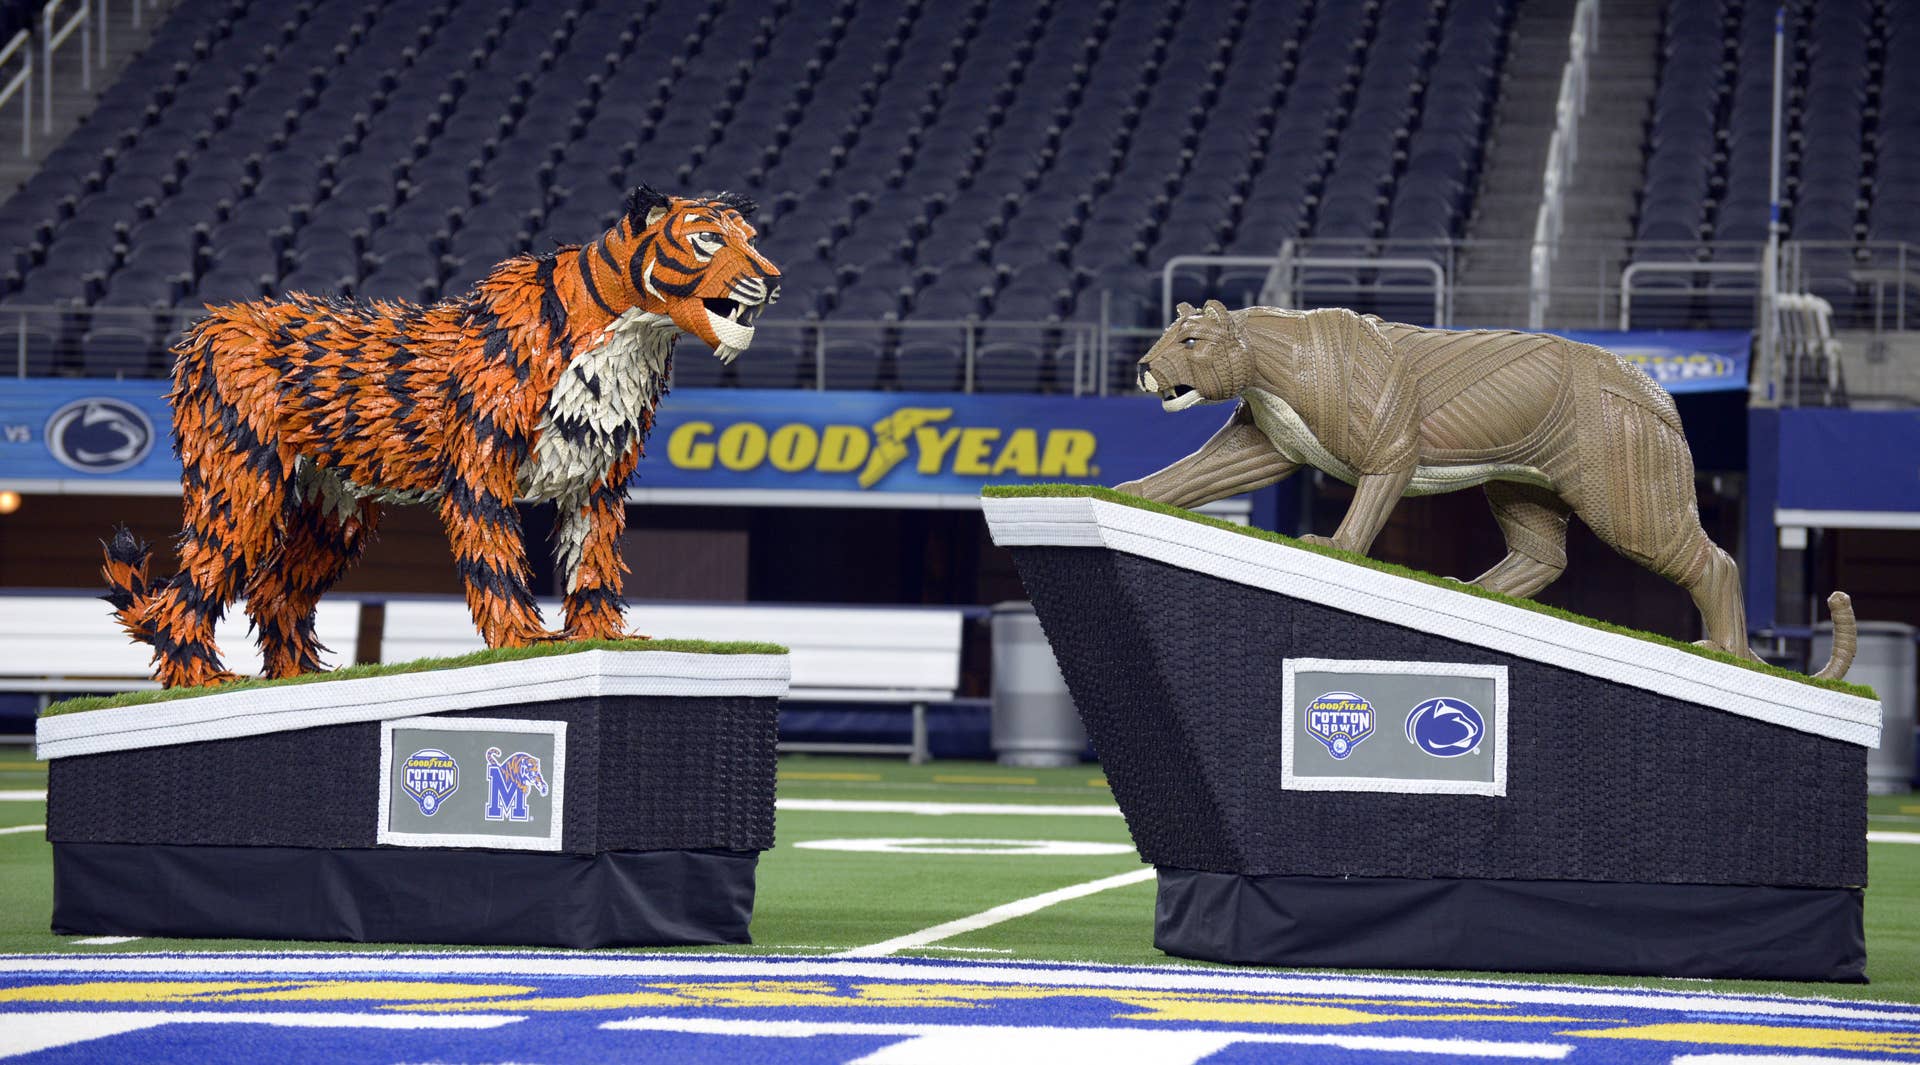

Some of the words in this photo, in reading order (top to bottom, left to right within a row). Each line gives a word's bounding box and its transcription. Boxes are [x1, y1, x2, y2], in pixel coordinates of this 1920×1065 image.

[667, 419, 1098, 479] GOODYEAR
[1313, 702, 1368, 711] GOODYEAR
[1311, 711, 1370, 733] COTTON
[1322, 724, 1359, 737] BOWL
[408, 759, 453, 768] GOODYEAR
[406, 769, 454, 789] COTTON
[415, 780, 446, 794] BOWL
[485, 765, 529, 822] M
